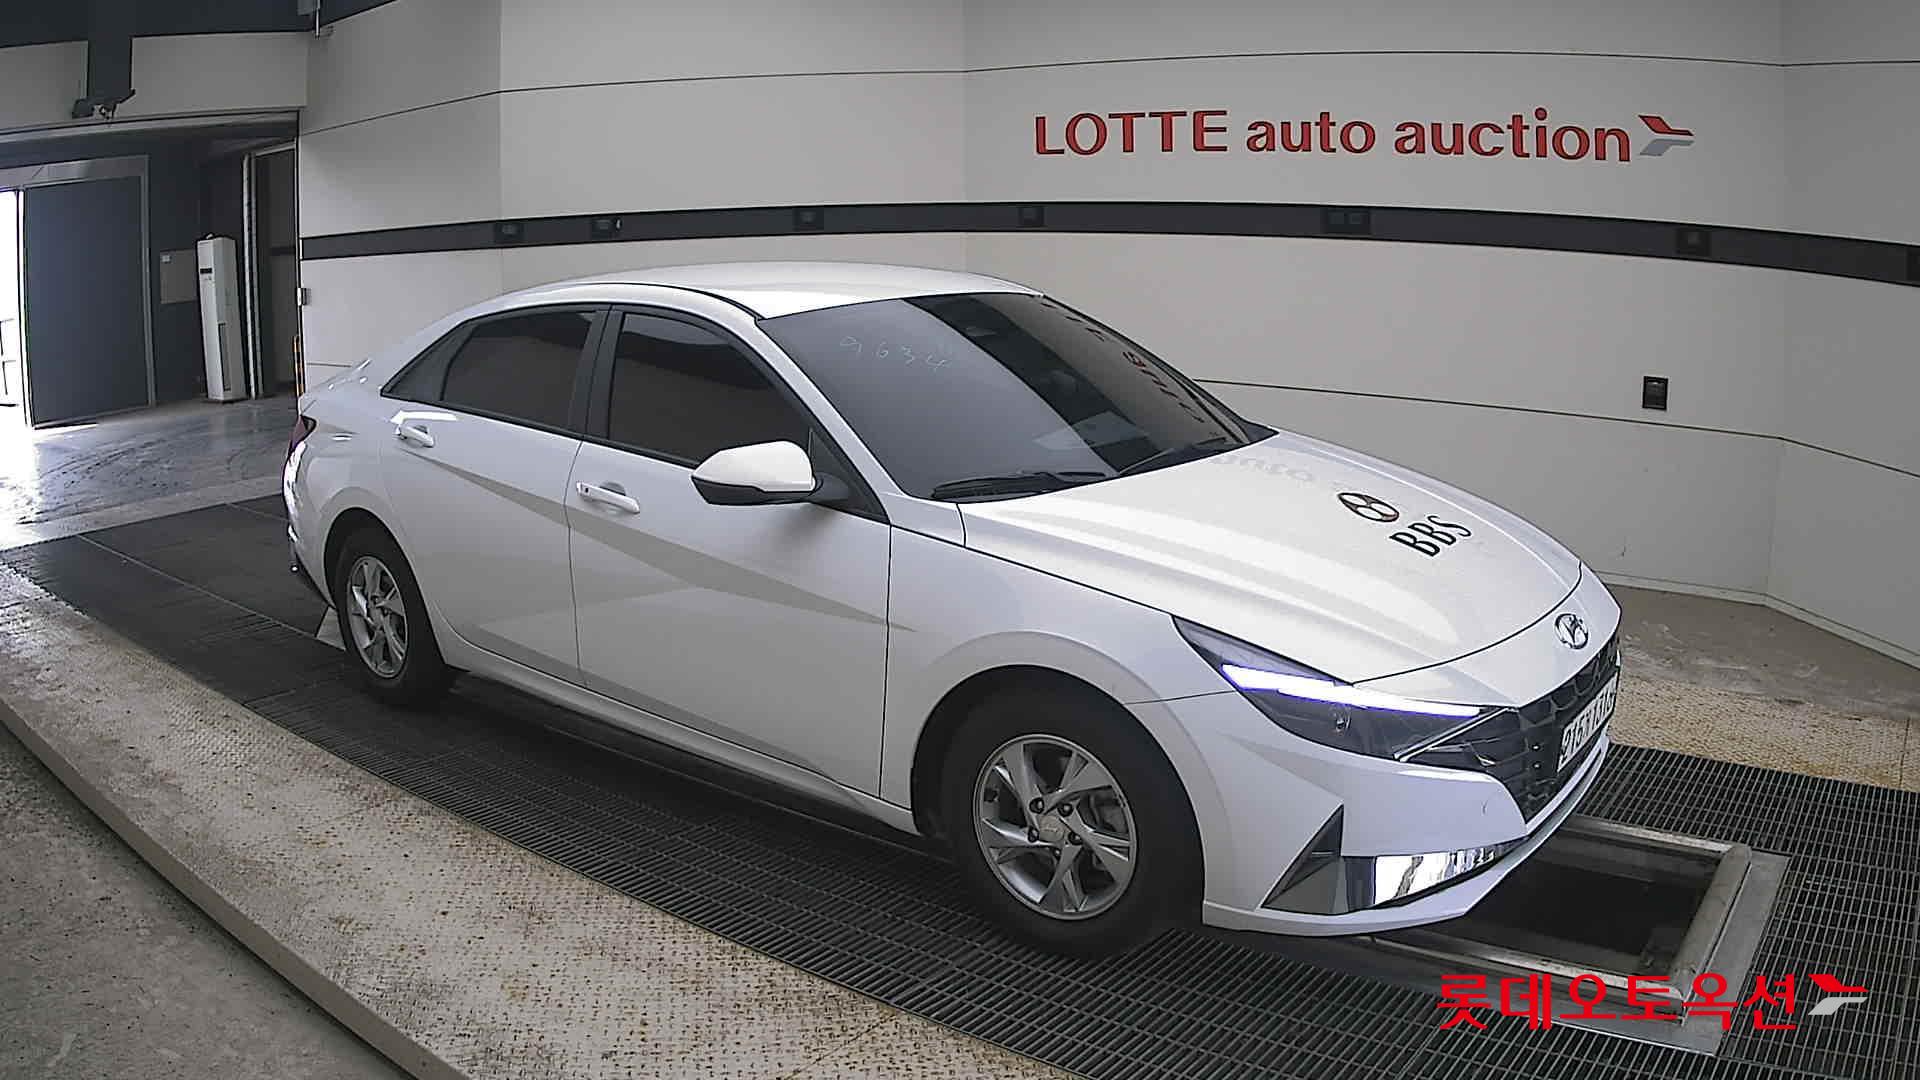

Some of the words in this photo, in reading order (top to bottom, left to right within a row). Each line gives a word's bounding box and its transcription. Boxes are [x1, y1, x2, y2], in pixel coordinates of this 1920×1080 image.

[1035, 110, 1228, 155] LOTTE
[1246, 111, 1376, 154] auto
[1394, 107, 1631, 162] auction
[1389, 515, 1472, 557] BBS
